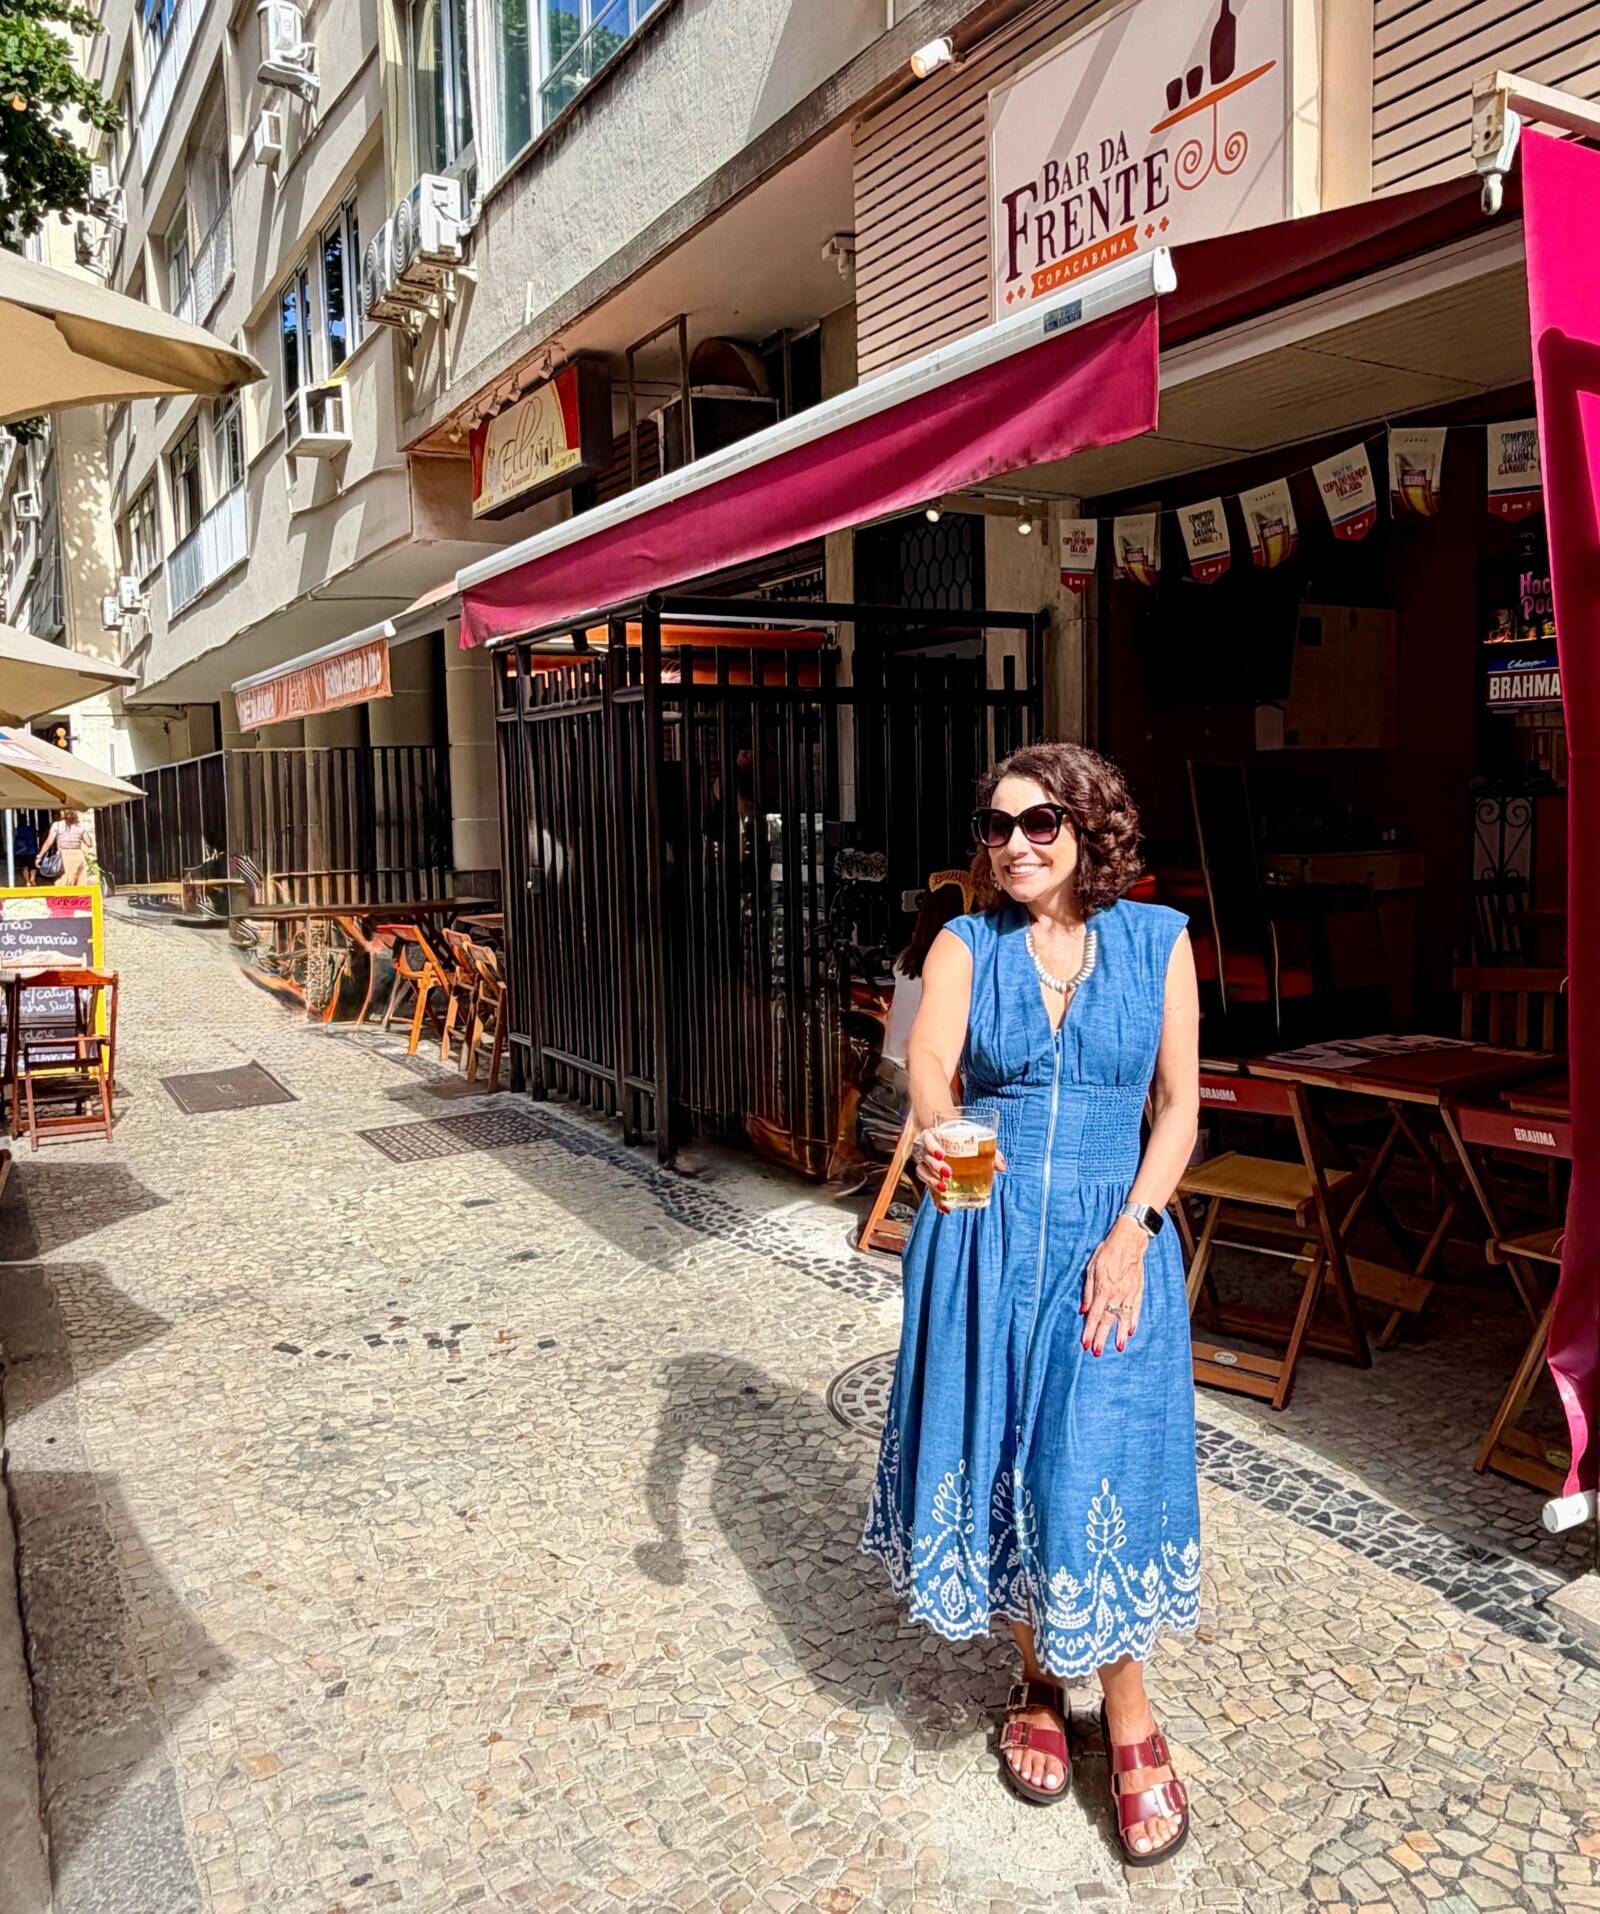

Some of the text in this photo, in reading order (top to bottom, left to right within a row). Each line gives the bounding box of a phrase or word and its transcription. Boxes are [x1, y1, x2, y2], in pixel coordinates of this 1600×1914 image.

[1042, 129, 1130, 206] BAR DA
[1001, 147, 1170, 284] FRENTE
[1036, 237, 1129, 290] COPACABANA
[1489, 672, 1561, 700] BRAHMA
[1200, 1087, 1238, 1102] BRAHMA
[1513, 1127, 1557, 1147] BRAHMA
